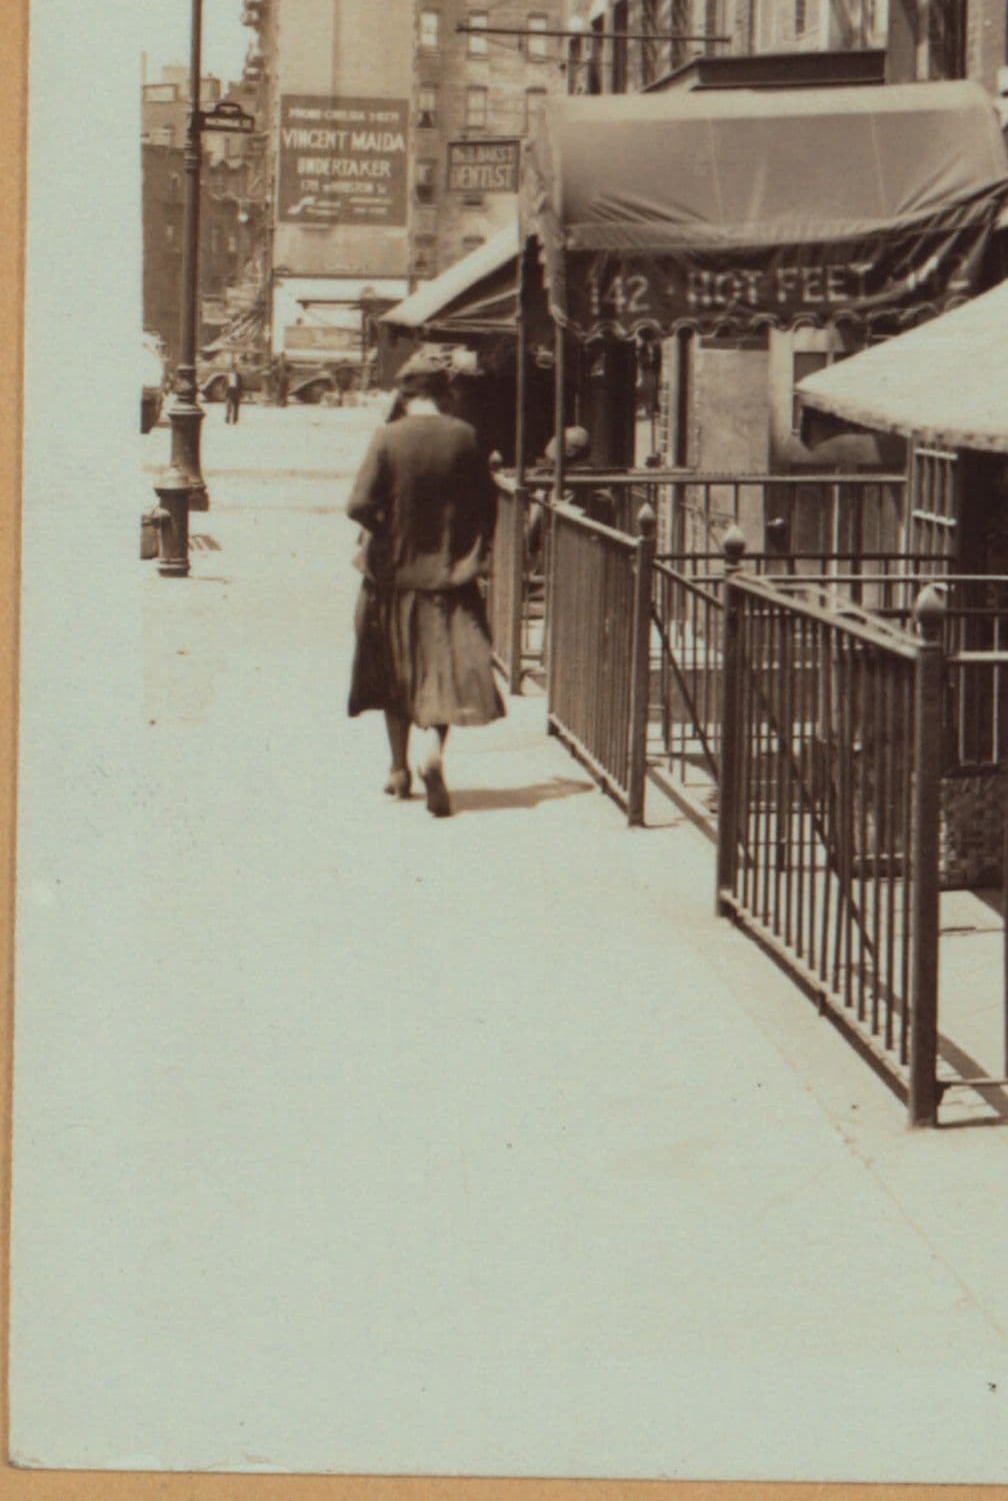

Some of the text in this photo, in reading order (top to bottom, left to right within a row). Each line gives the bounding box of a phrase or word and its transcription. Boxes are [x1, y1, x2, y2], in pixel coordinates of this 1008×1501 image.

[282, 128, 405, 152] VINCENT MAIDA
[296, 156, 392, 178] UNDERTAKER
[590, 271, 649, 314] 142
[687, 269, 763, 306] HOT
[777, 263, 873, 304] FEET
